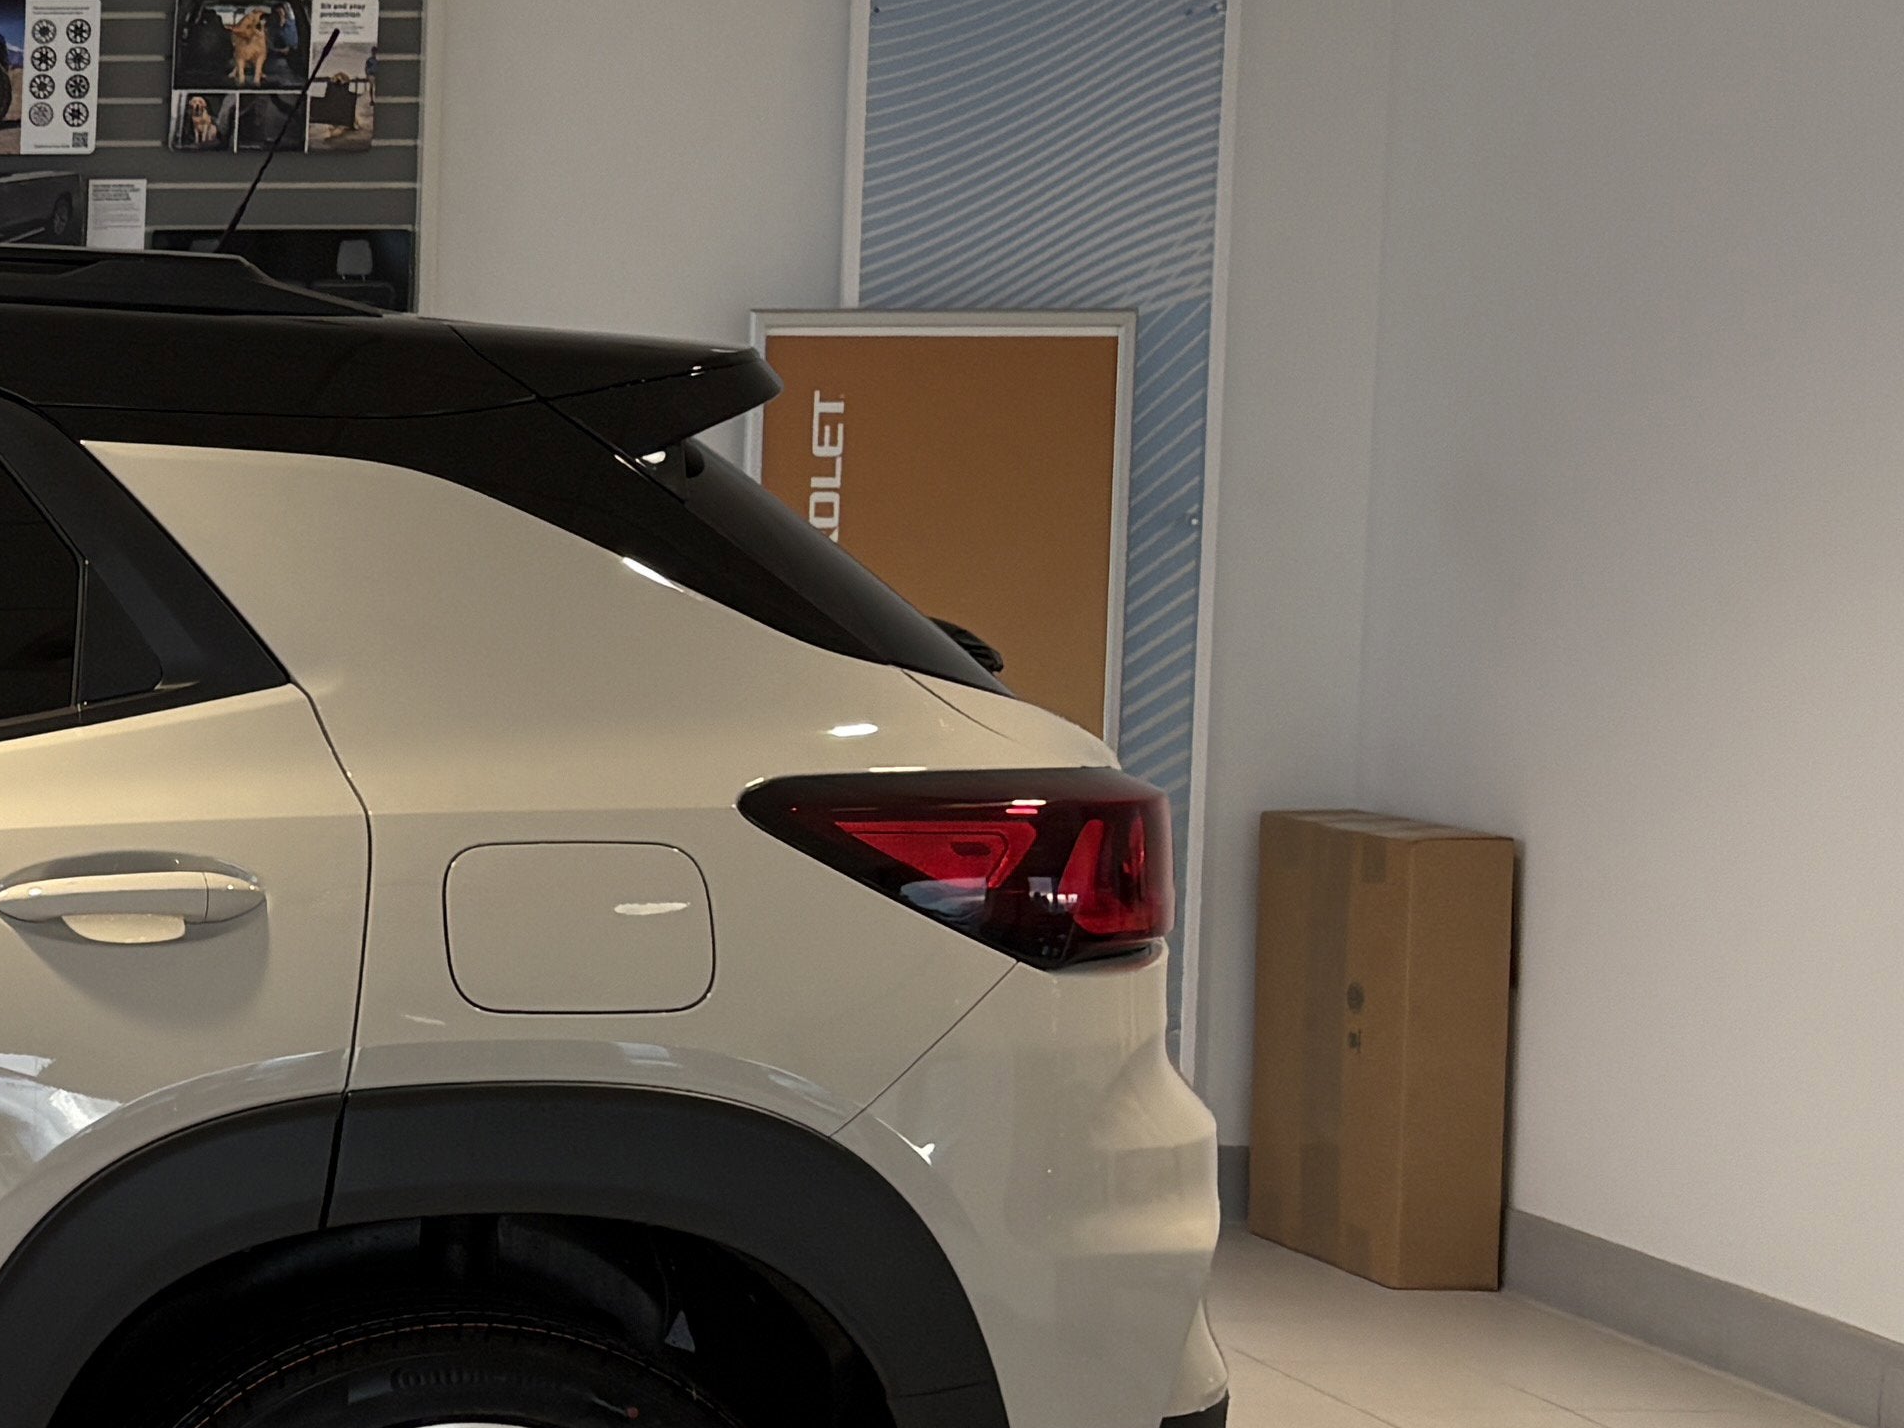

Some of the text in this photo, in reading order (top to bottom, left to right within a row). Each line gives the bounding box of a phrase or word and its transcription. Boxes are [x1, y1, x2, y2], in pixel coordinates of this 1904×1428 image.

[333, 2, 347, 10] and
[349, 3, 366, 11] stay
[809, 390, 845, 543] OLET
